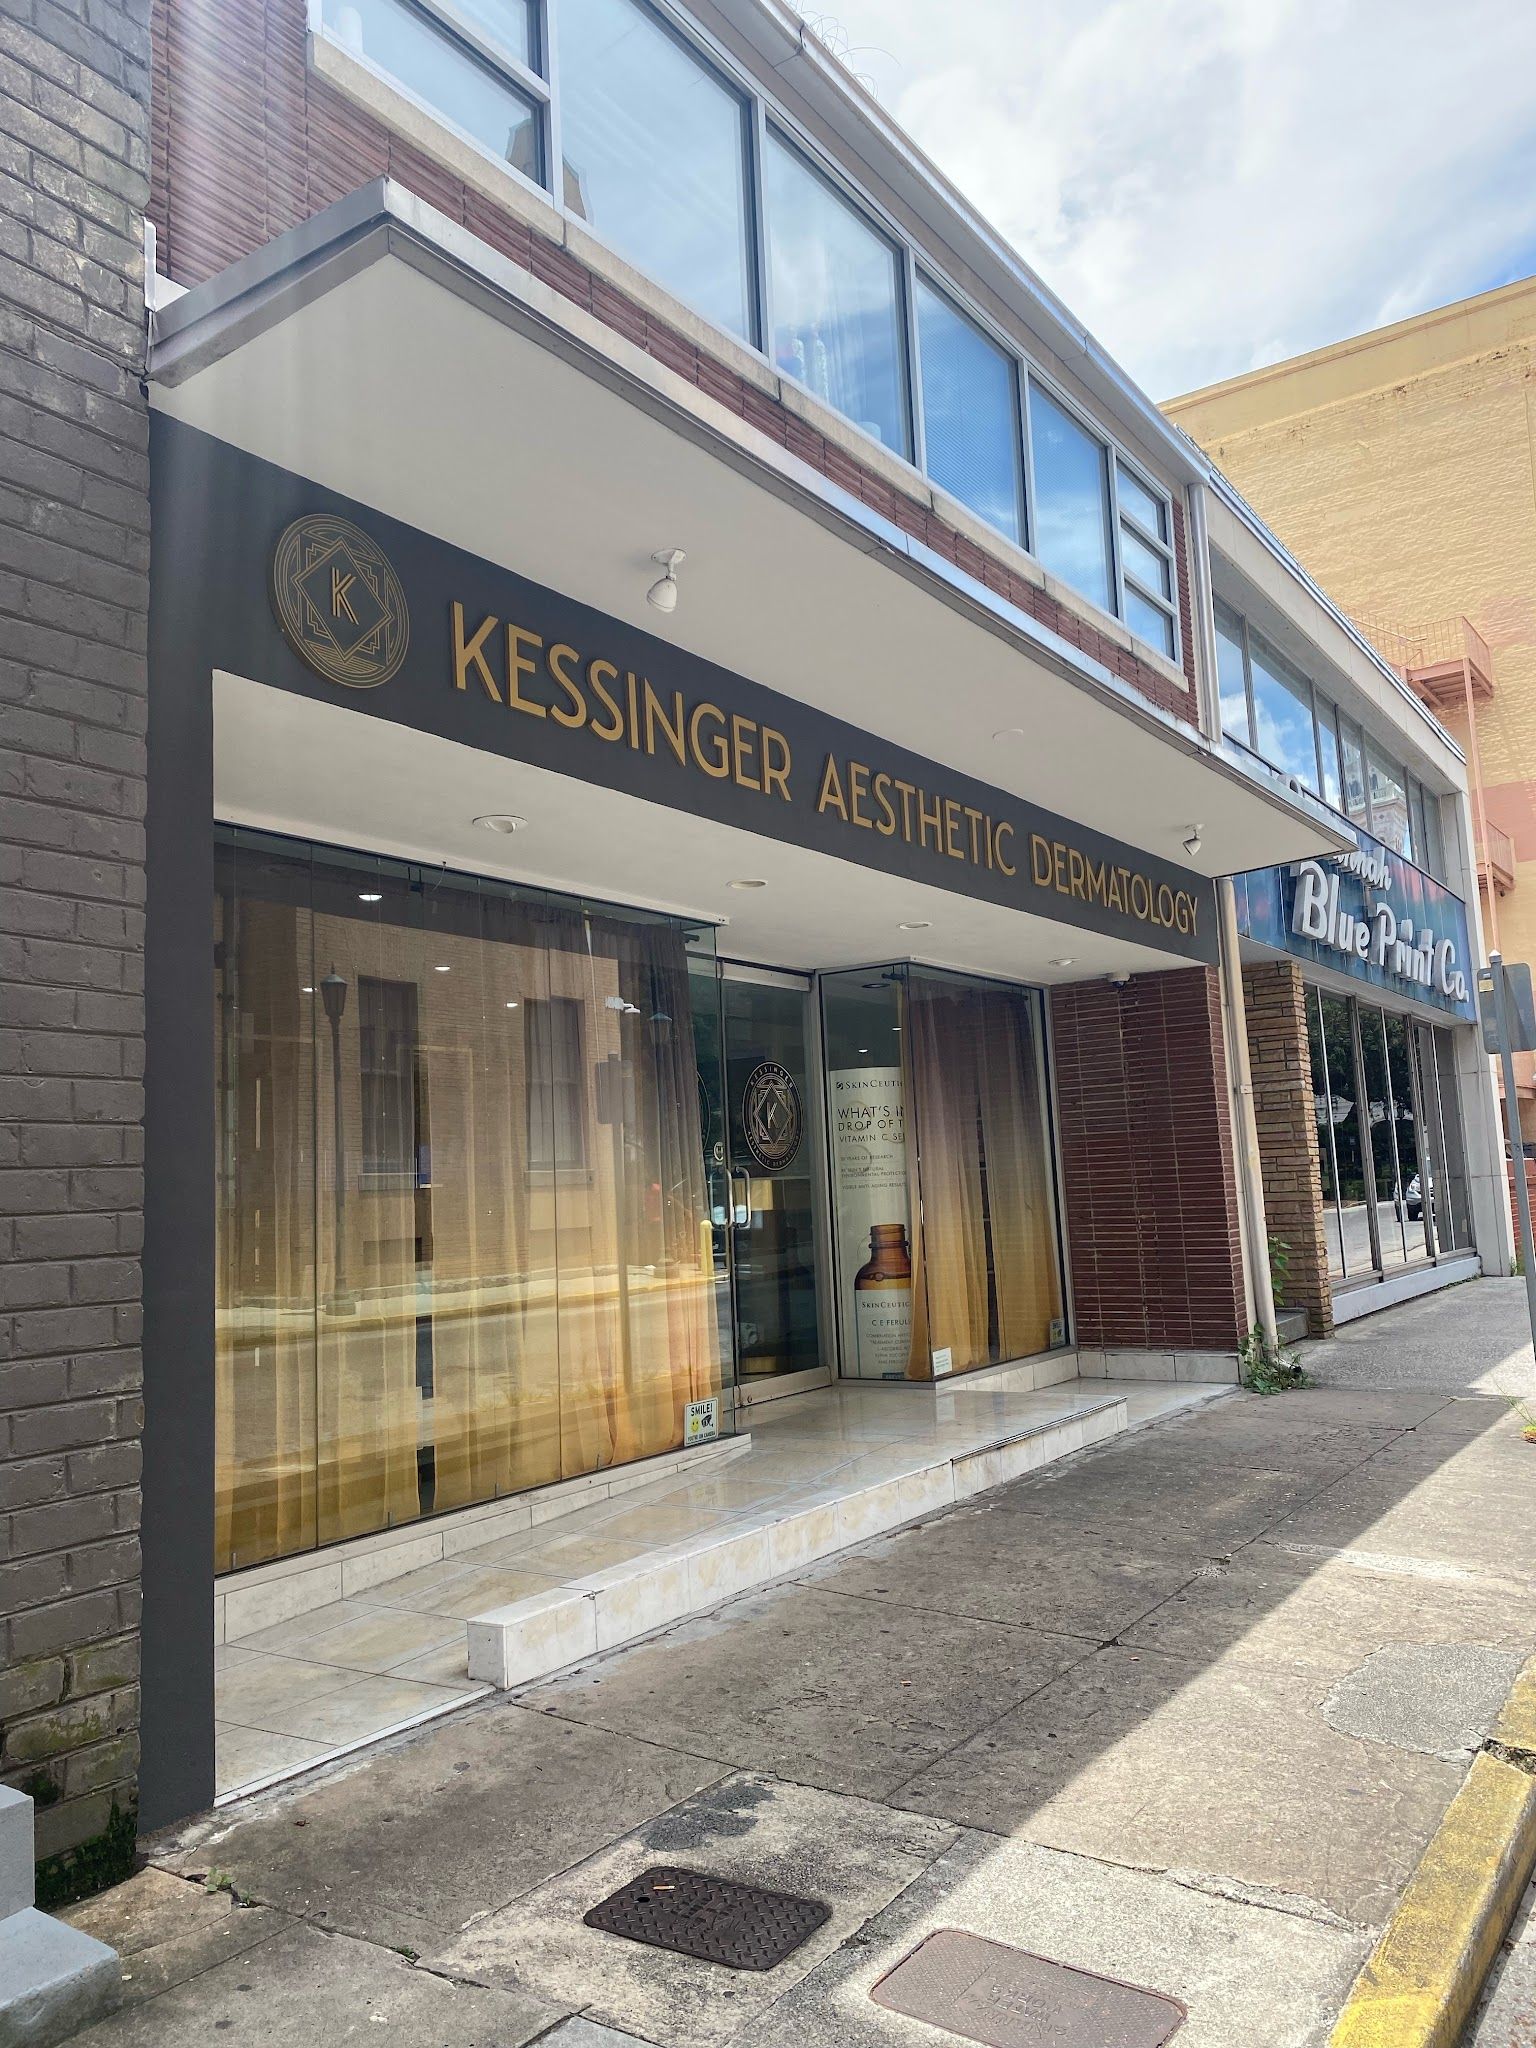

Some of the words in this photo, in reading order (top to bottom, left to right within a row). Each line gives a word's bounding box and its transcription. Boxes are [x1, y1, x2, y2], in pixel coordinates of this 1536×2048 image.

[331, 566, 359, 625] K
[450, 600, 792, 802] KESSINGER
[817, 753, 1017, 876] AESTHETIC
[1029, 833, 1198, 936] DERMATOLOGY
[1293, 861, 1371, 959] Blue
[1372, 902, 1435, 986] Print
[1437, 938, 1470, 1003] Co.
[838, 1105, 891, 1119] WHAT'S
[838, 1120, 872, 1132] DROP
[877, 1119, 894, 1129] OF
[839, 1134, 876, 1143] VITAMIN
[882, 1133, 888, 1141] C
[690, 1402, 713, 1417] SMILE!
